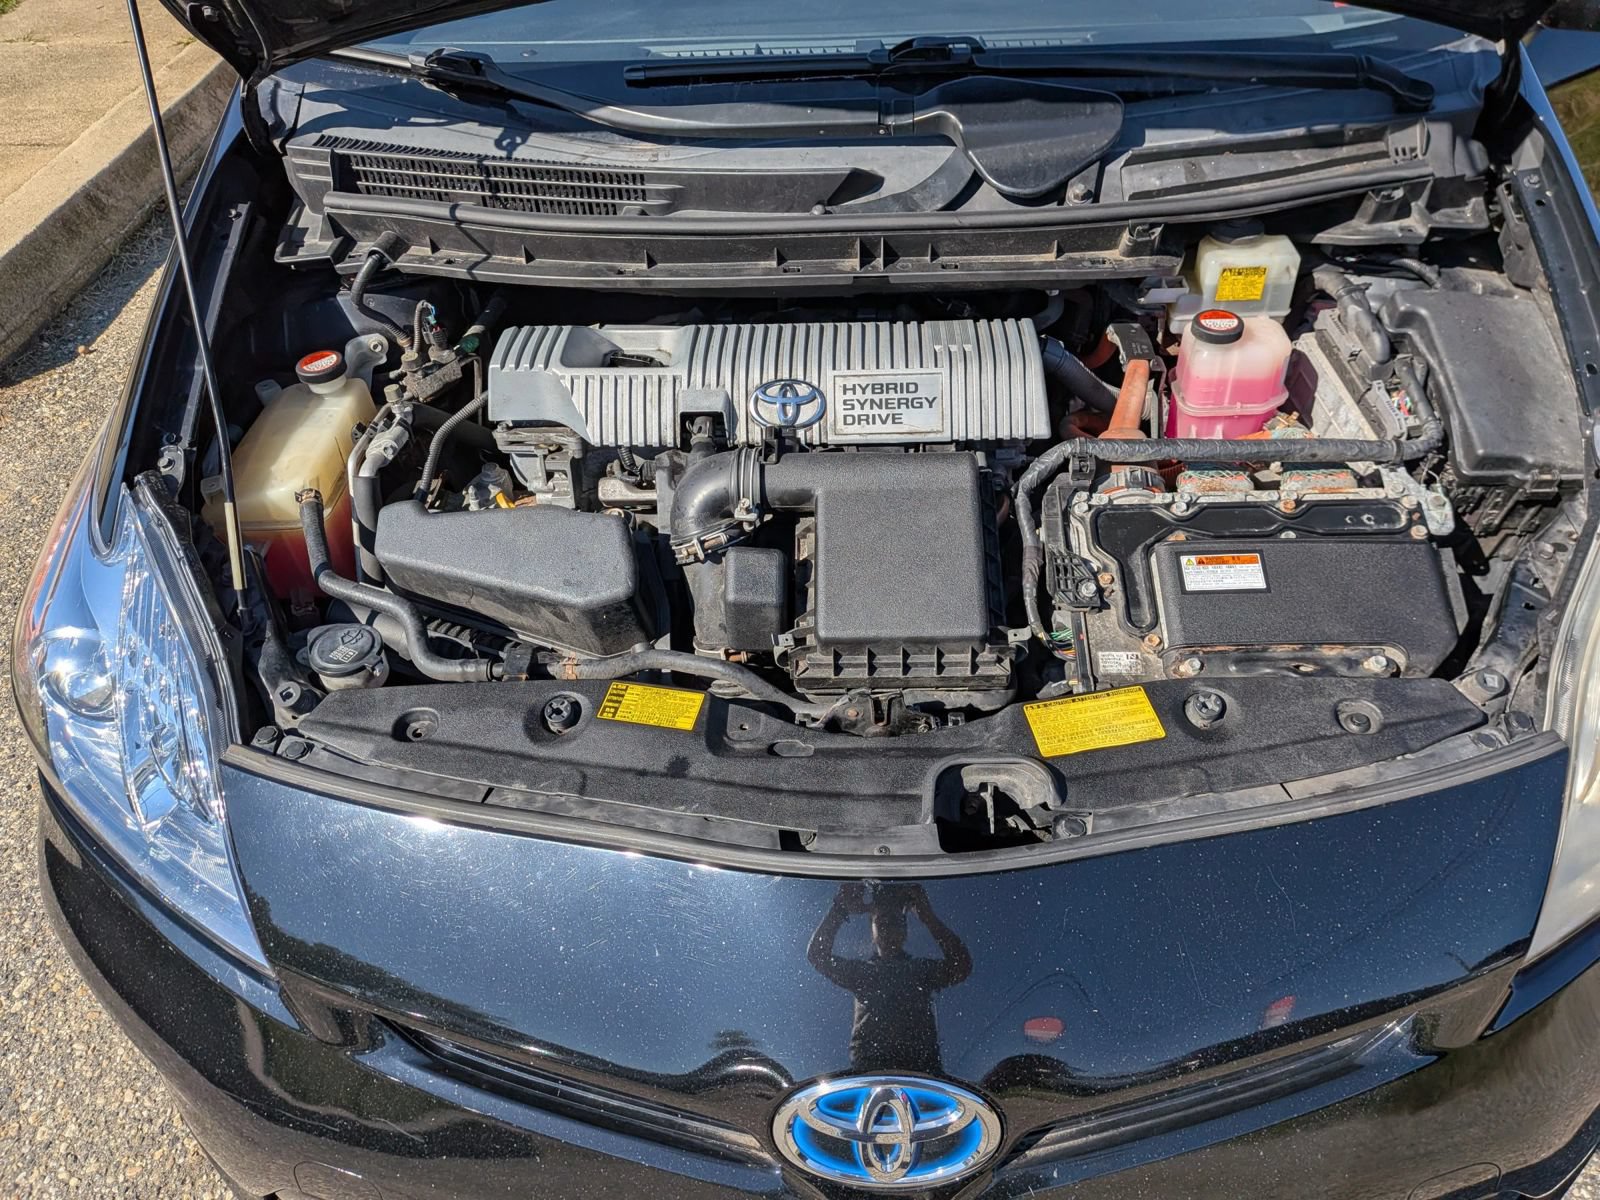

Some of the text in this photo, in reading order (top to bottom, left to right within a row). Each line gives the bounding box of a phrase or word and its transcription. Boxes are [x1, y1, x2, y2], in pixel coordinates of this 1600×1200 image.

[843, 382, 919, 395] HYBRID
[843, 396, 938, 411] SYNERGY
[843, 413, 904, 426] DRIVE
[1075, 693, 1107, 703] ATTENTION
